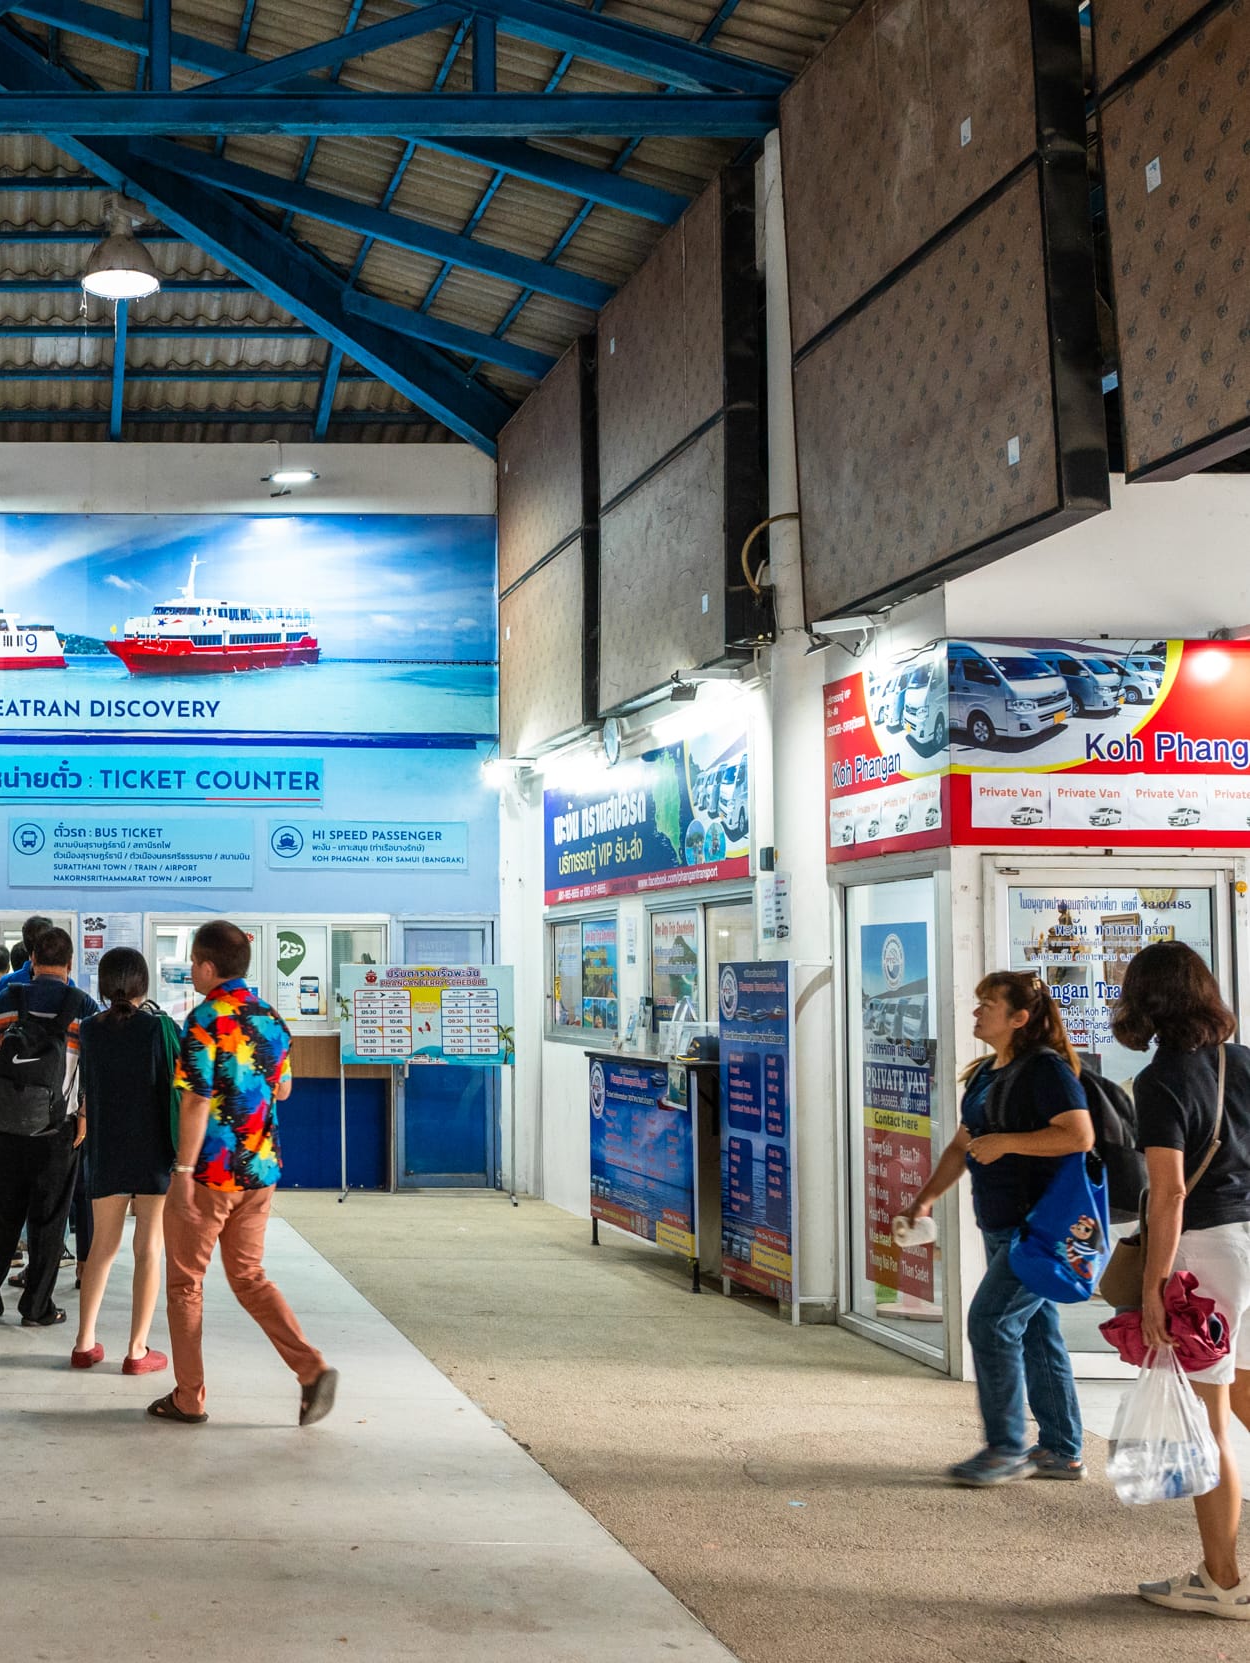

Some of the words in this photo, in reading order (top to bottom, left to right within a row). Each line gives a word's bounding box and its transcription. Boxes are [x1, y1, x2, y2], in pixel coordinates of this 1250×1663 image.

[25, 632, 38, 653] 9
[90, 700, 220, 718] DISCOVERY
[1086, 733, 1142, 760] Koh
[99, 769, 186, 790] TICKET
[195, 770, 320, 791] COUNTER
[833, 759, 852, 789] Koh
[855, 753, 901, 783] Phangan
[979, 787, 1018, 798] Private
[1021, 788, 1042, 798] Van
[1057, 788, 1096, 799] Private
[1099, 789, 1121, 799] Van
[1135, 789, 1174, 799] Private
[1177, 789, 1199, 799] Van
[54, 822, 87, 838] ตั๋วรถ
[95, 828, 118, 838] BUS
[122, 828, 163, 838] TICKET
[312, 830, 325, 840] HI
[329, 831, 368, 841] SPEED
[372, 831, 442, 841] PASSENGER
[598, 842, 613, 867] VIP
[615, 832, 643, 864] รับ-ส่ง
[1055, 918, 1087, 936] พะงัน
[1095, 918, 1168, 936] ทรานสปอร์ต
[1050, 984, 1089, 1004] ngan
[1085, 1007, 1099, 1016] Koh
[866, 1066, 905, 1092] PRIVATE
[906, 1071, 927, 1095] VAN
[874, 1112, 900, 1128] Contact
[902, 1116, 919, 1130] Here
[902, 1260, 915, 1279] Than
